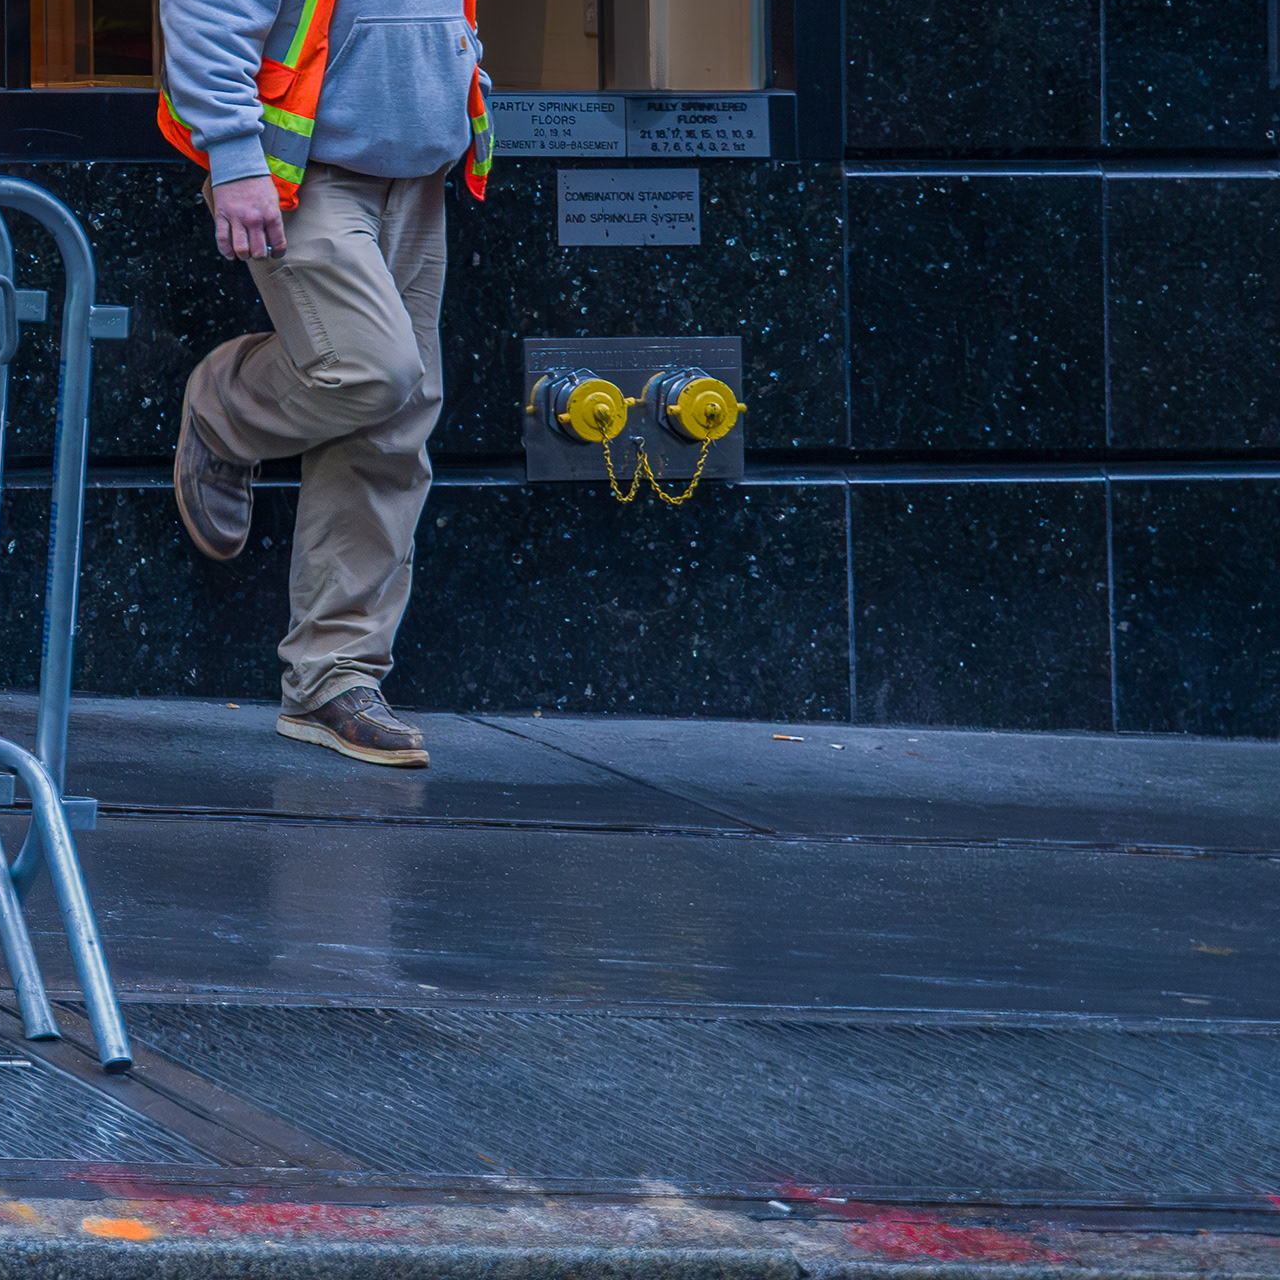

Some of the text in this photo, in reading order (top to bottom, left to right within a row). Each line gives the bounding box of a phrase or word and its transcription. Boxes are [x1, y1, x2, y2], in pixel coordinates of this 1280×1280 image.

[492, 101, 615, 113] PARTLY SPRINKLERED
[647, 102, 748, 112] FULLY SPRINKLERED
[531, 115, 577, 125] FLOORS
[677, 115, 719, 124] FLOORS
[494, 140, 619, 151] ASEMENT & SUB-BASEMENT
[564, 191, 694, 202] COMBINATION STANDPIPE
[565, 212, 695, 223] AND SPRINKLER SYSTEM
